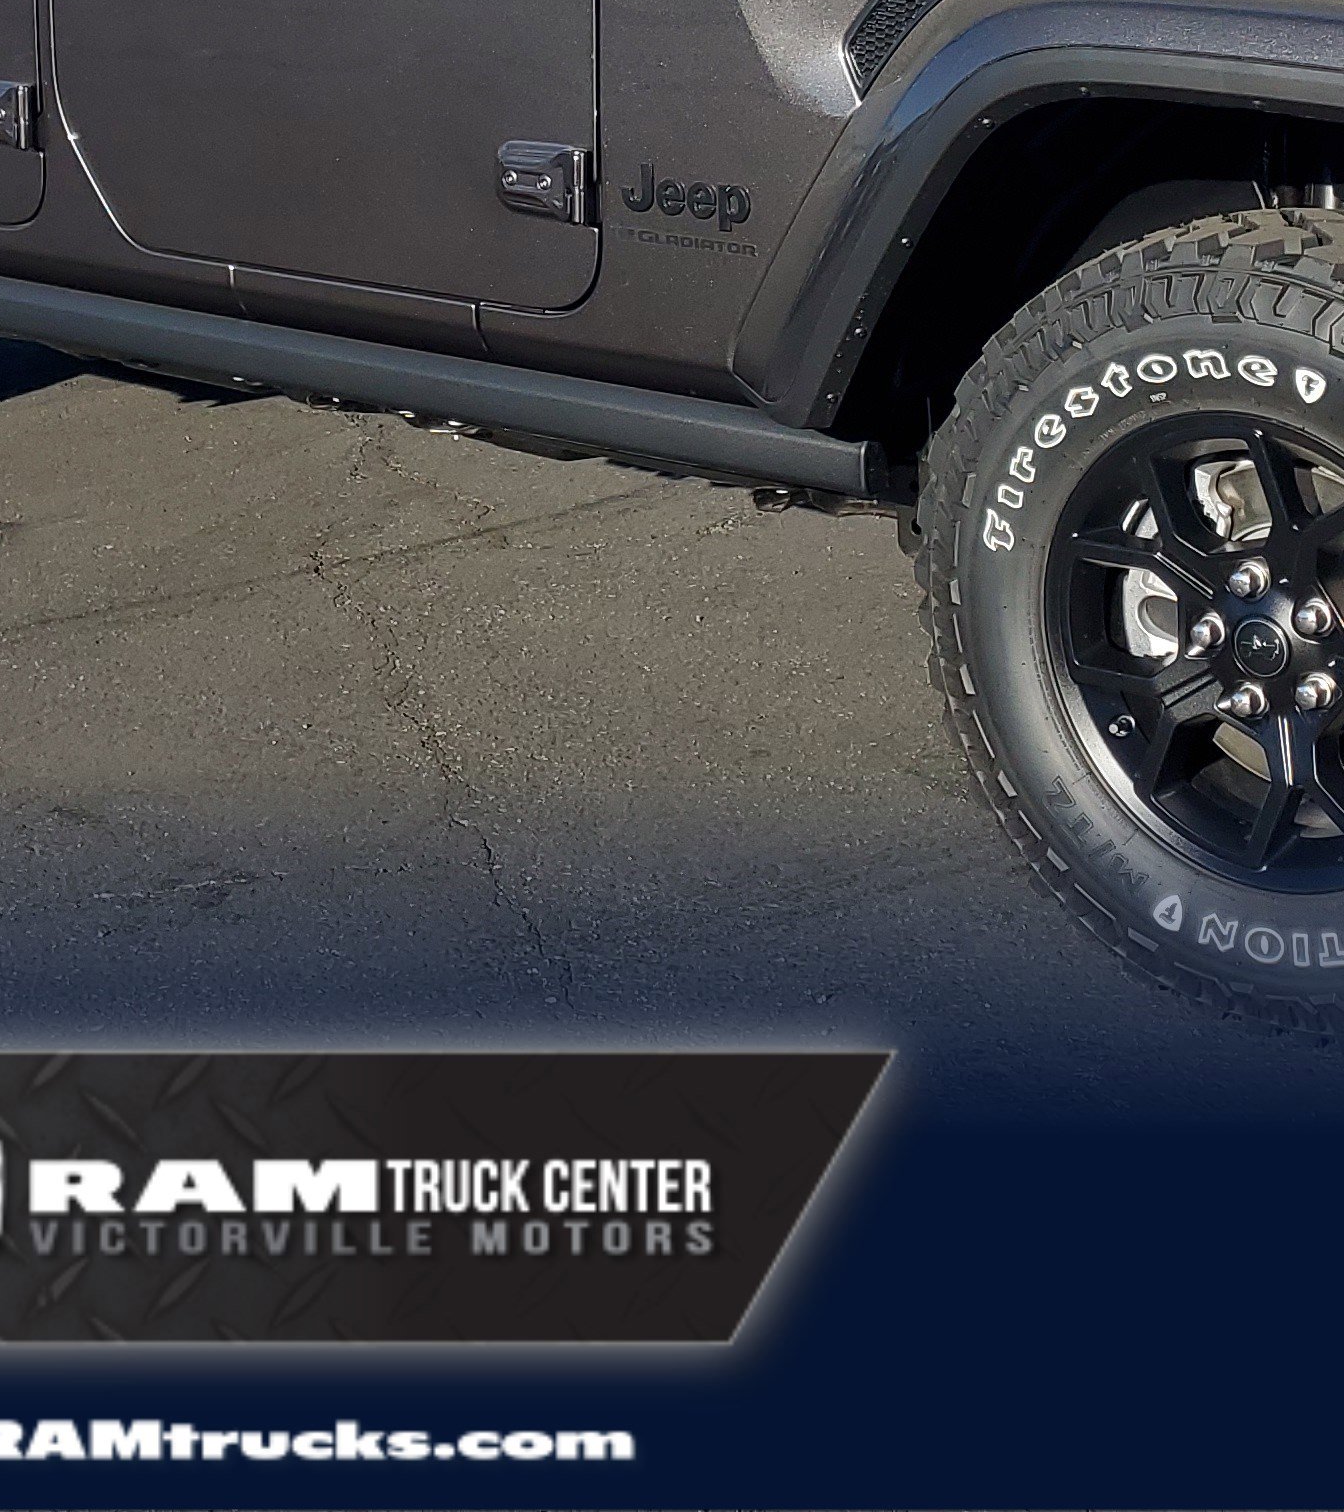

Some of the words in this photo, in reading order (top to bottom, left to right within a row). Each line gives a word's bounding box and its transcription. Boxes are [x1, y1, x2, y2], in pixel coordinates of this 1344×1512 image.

[621, 162, 752, 232] Jeep
[637, 229, 758, 257] GLADIATOR
[983, 350, 1278, 554] Firestone
